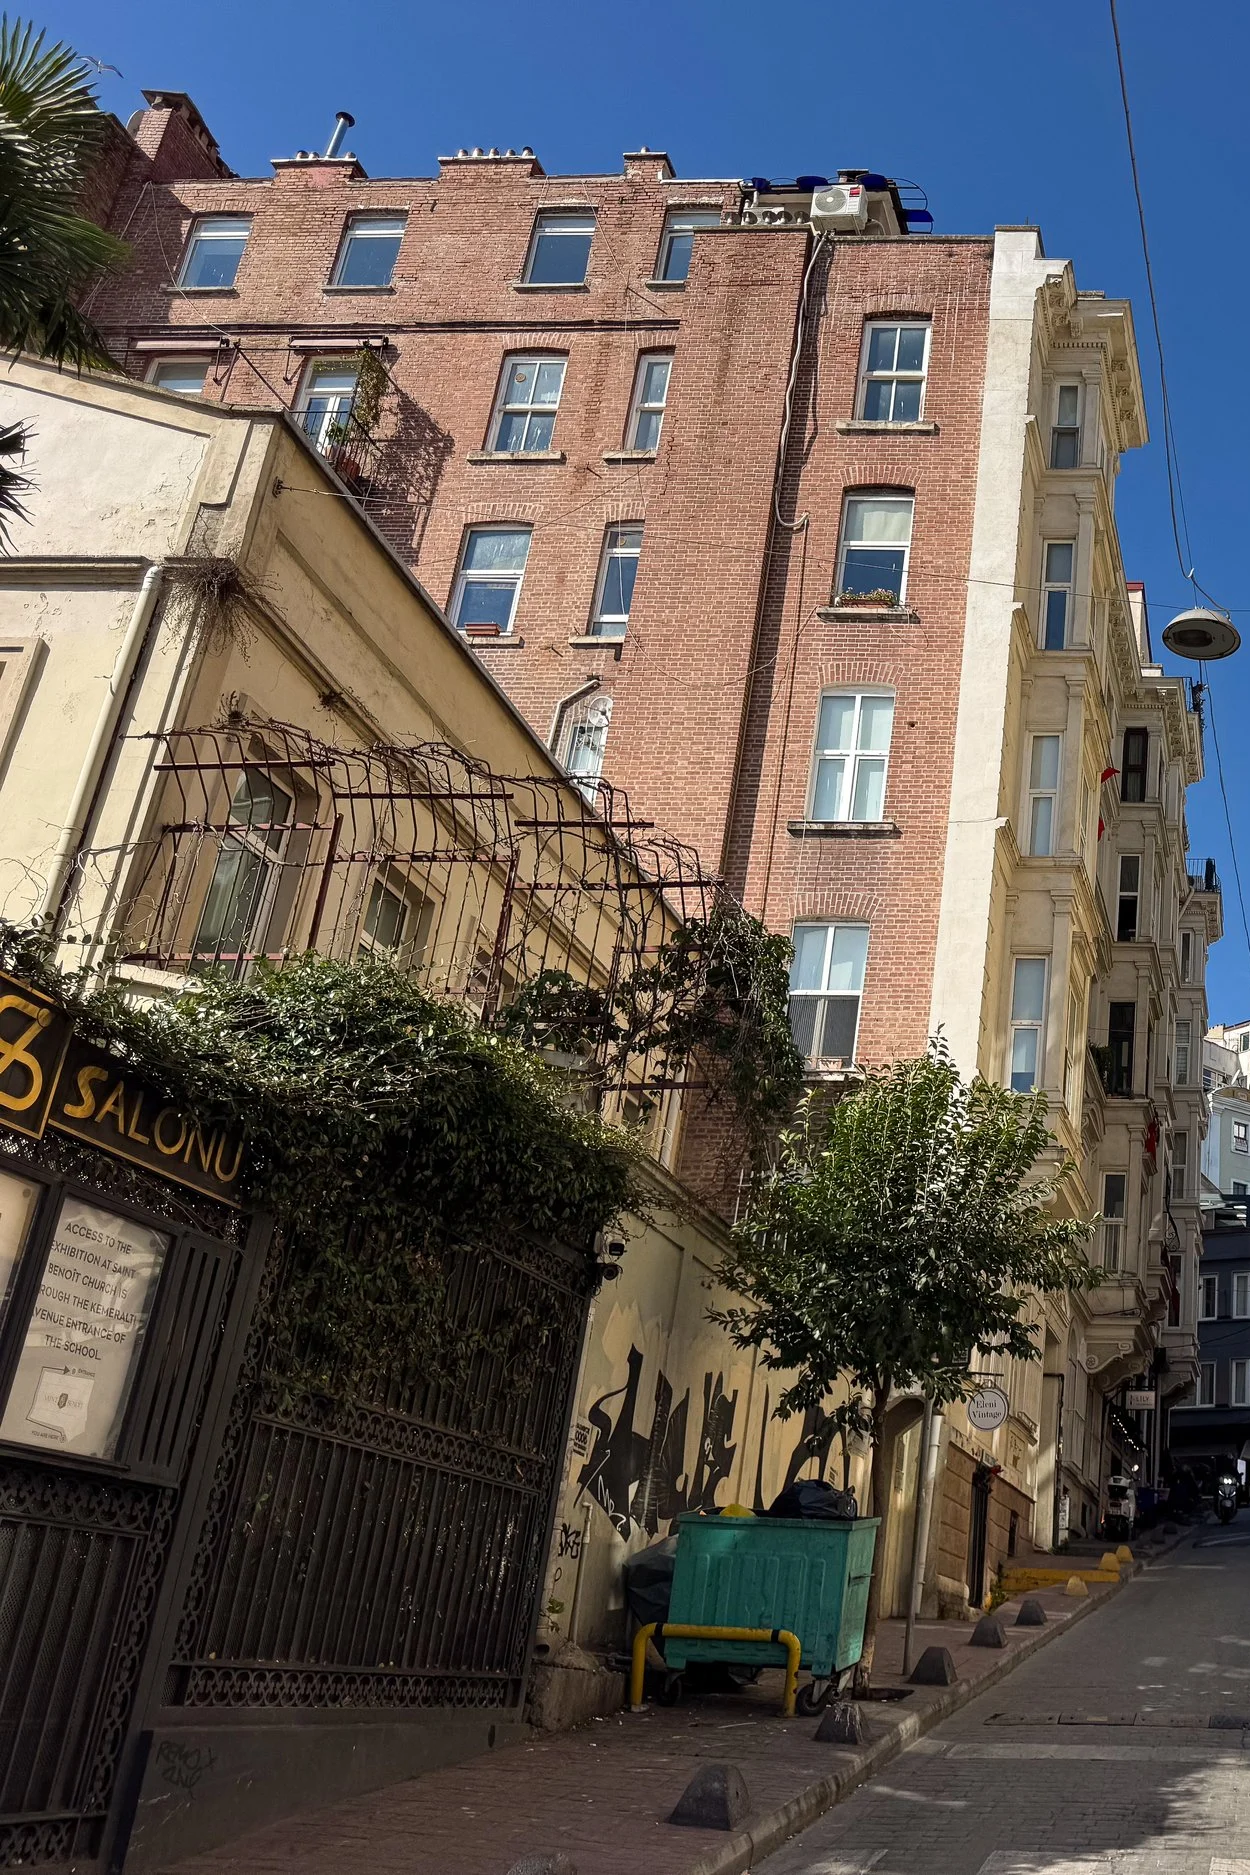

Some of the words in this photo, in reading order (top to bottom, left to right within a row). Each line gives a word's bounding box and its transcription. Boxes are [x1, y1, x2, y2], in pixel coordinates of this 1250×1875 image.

[63, 1065, 246, 1183] SALONU
[65, 1222, 103, 1243] ACCESS
[105, 1235, 115, 1248] TO
[117, 1240, 132, 1254] THE
[101, 1258, 112, 1270] AT
[112, 1263, 136, 1278] SAINT
[39, 1284, 70, 1304] ROUGH
[73, 1295, 89, 1310] THE
[82, 1275, 117, 1297] CHURCH
[118, 1288, 128, 1299] IS
[66, 1317, 113, 1340] ENTRANCE
[113, 1332, 127, 1344] OF
[45, 1334, 61, 1348] THE
[63, 1340, 102, 1360] SCHOOL
[972, 1411, 1002, 1419] Vintage
[976, 1400, 997, 1408] Eleni
